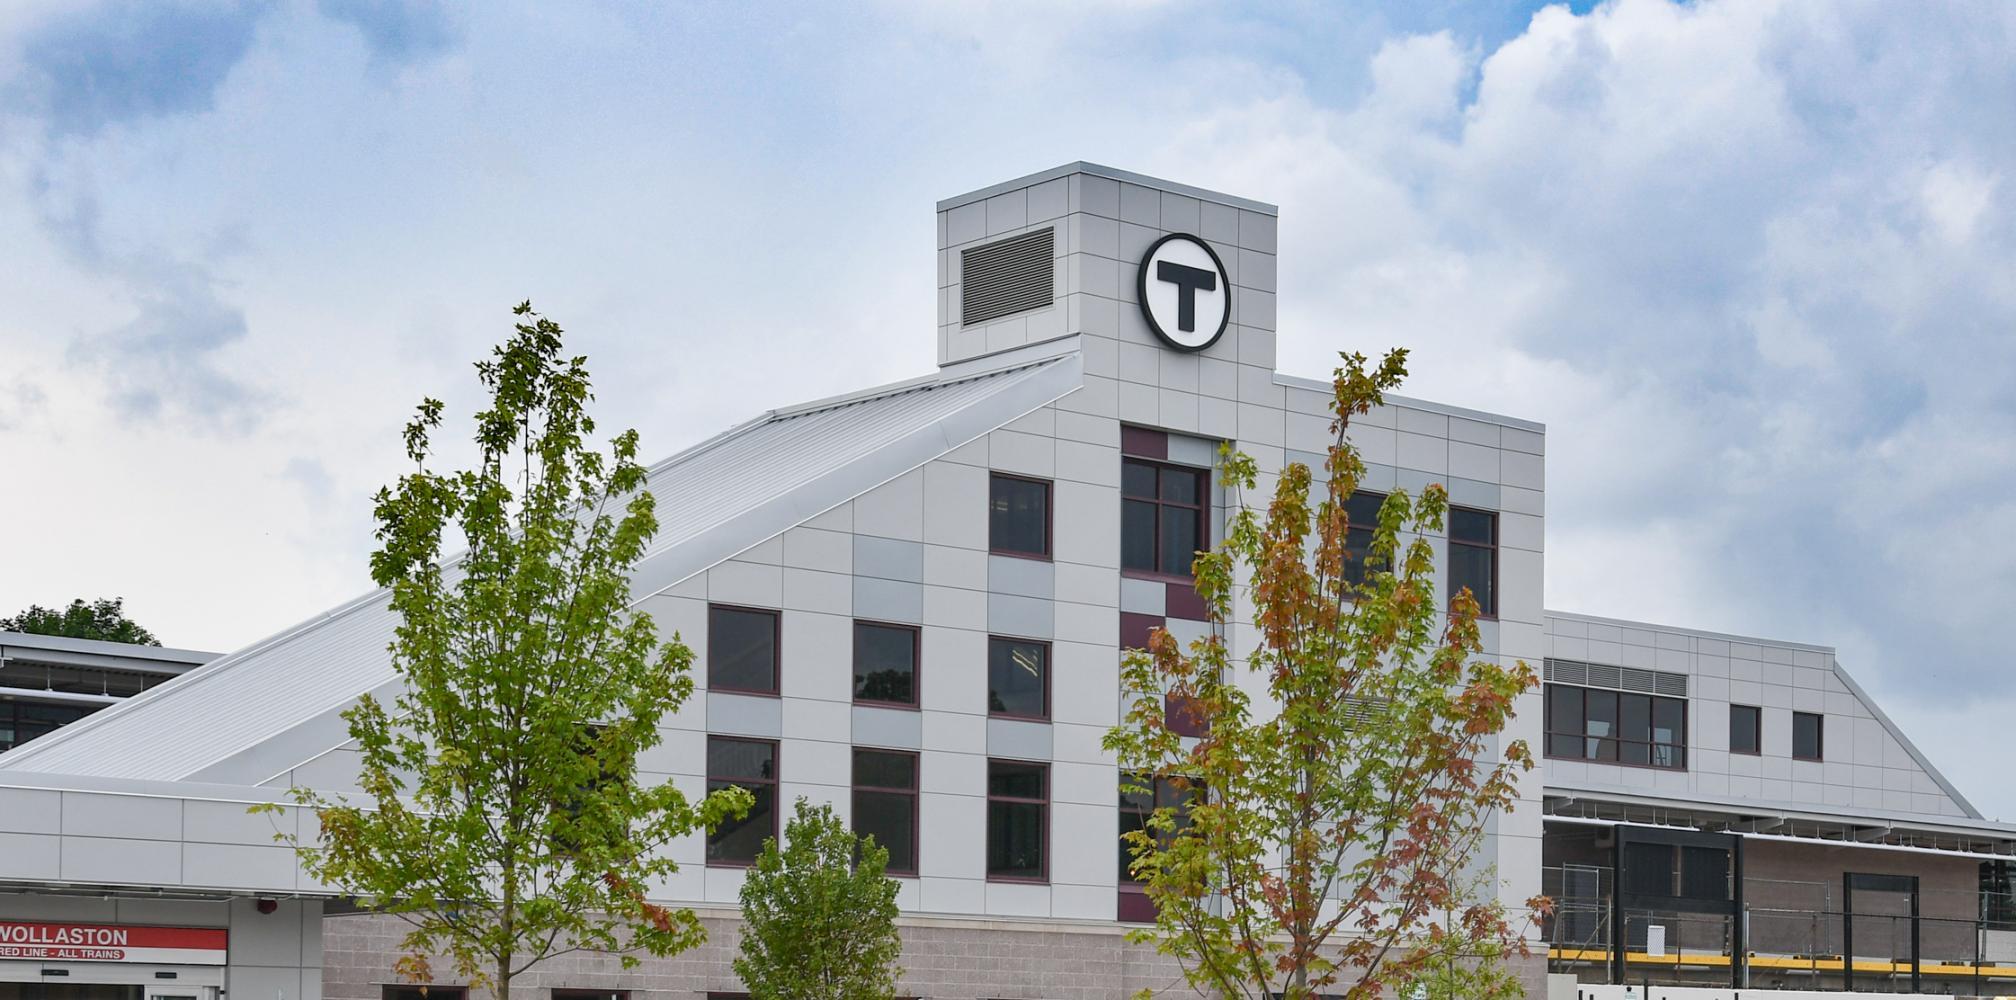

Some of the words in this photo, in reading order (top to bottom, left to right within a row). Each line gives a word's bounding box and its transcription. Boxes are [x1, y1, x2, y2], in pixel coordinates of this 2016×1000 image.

[1157, 260, 1216, 333] T
[0, 925, 127, 946] WOLLASTON
[0, 947, 20, 957] RED
[23, 948, 48, 957] LINE
[58, 949, 78, 958] ALL
[80, 950, 121, 959] TRAINS
